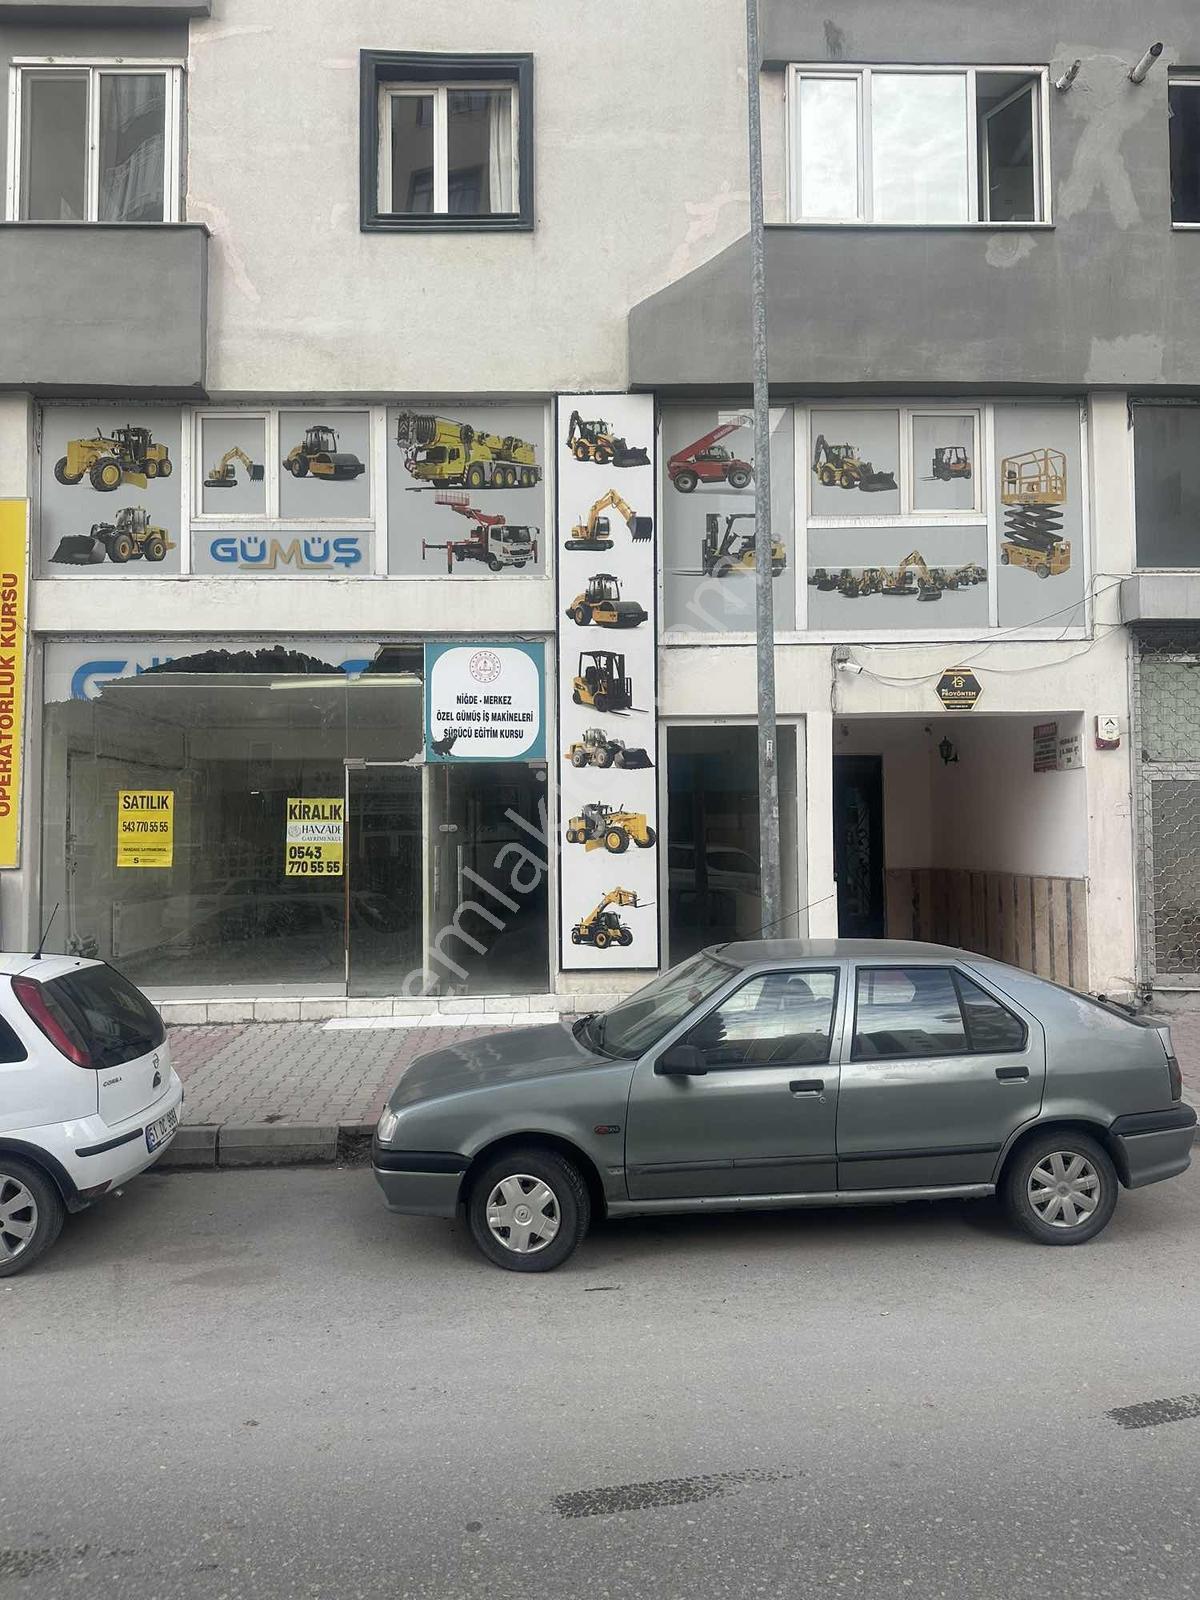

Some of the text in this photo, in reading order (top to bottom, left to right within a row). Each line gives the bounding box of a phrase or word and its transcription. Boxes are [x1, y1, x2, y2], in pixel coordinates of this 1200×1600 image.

[210, 537, 362, 569] GÜMÜŞ
[1, 573, 18, 648] KURSU
[456, 693, 478, 705] NİĞDE
[483, 695, 512, 705] MERKEZ
[436, 709, 534, 722] ÖZEL GÜMÜŞ İŞ MAKİNELERİ
[474, 727, 498, 739] EĞİTİM
[499, 729, 524, 739] KURSU
[123, 795, 169, 810] SATILIK
[289, 800, 343, 820] KİRALIK
[122, 821, 169, 832] 543 770 55 55
[289, 846, 322, 860] 0543
[288, 861, 340, 874] 770 55 55
